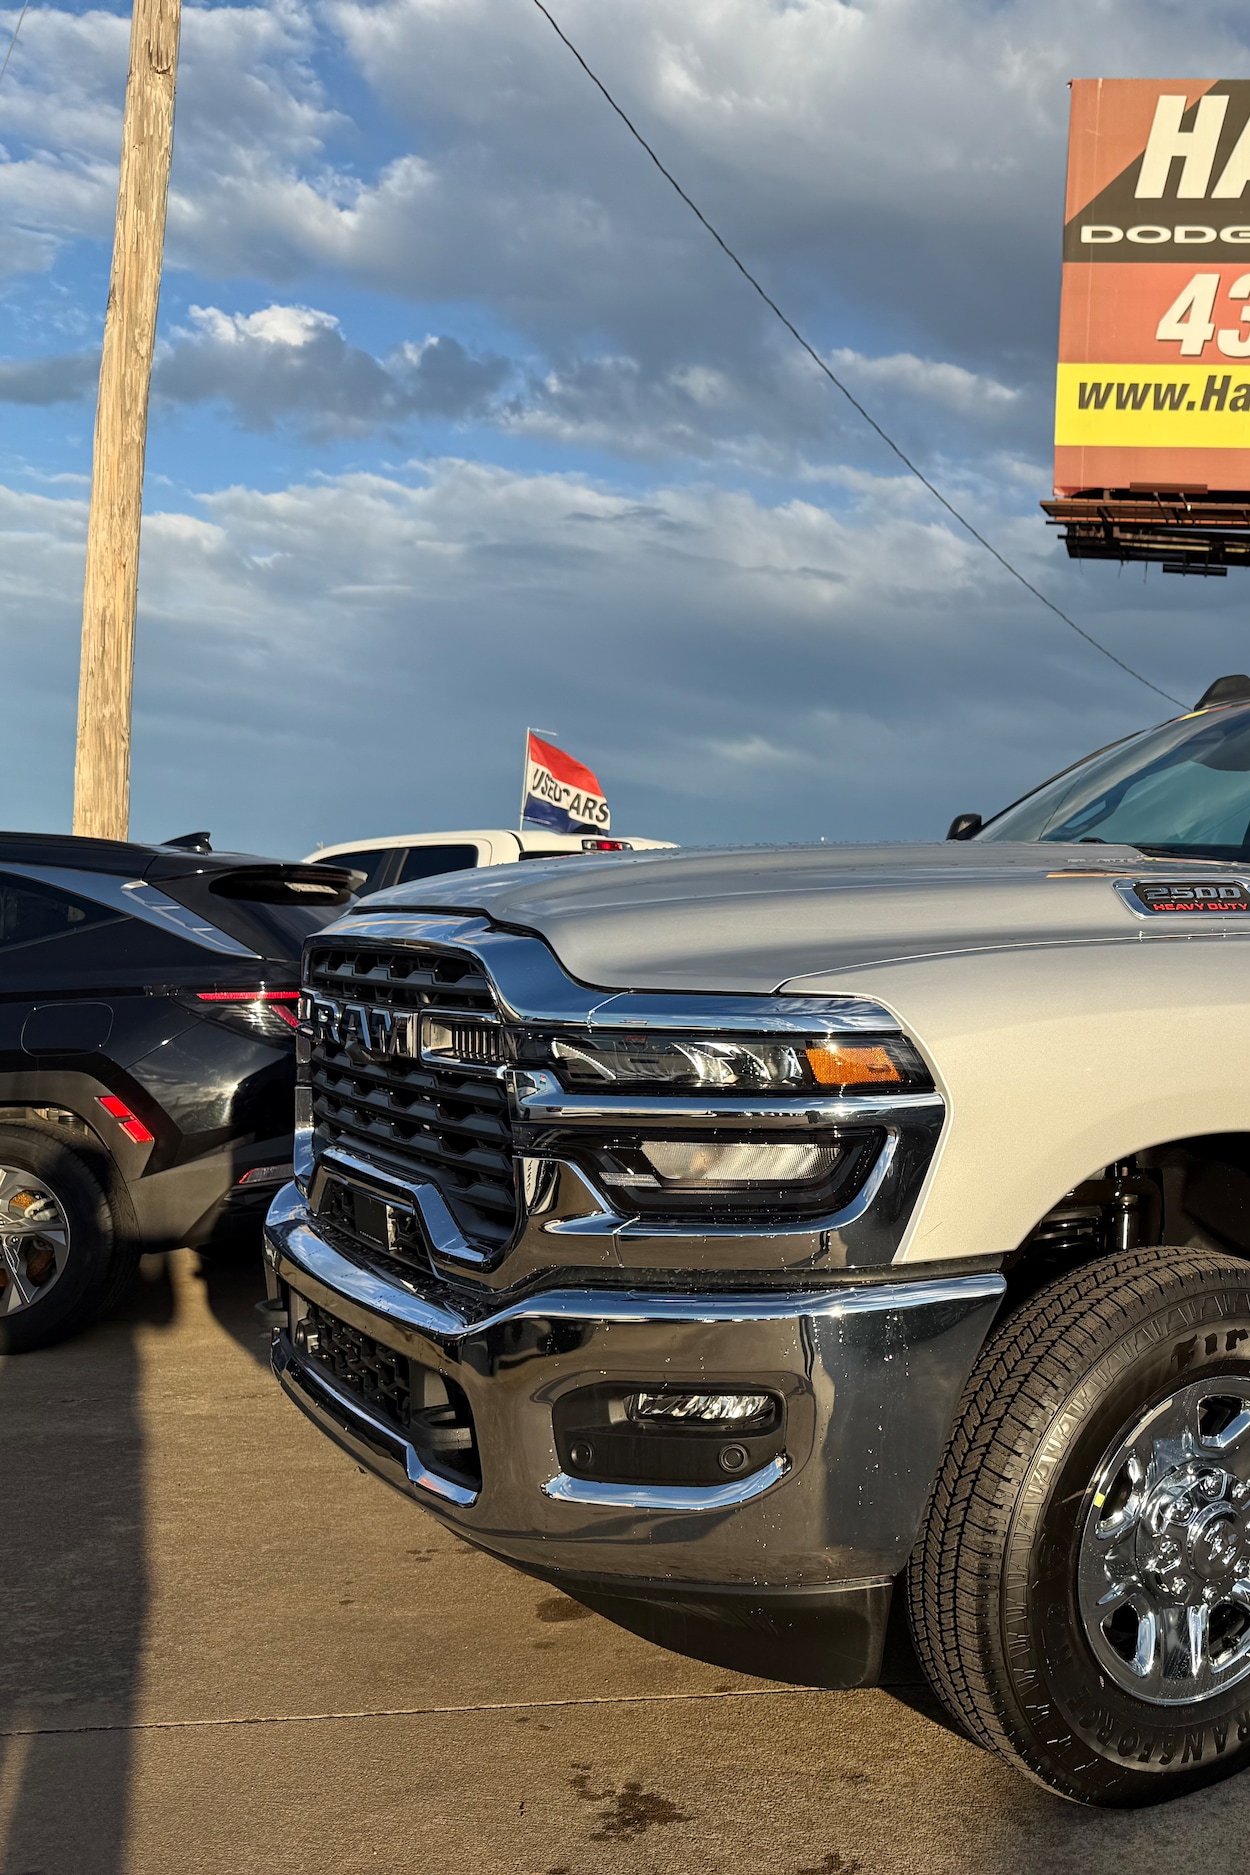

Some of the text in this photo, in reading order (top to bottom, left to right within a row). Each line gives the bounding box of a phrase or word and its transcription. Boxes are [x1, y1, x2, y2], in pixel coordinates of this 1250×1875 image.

[532, 768, 562, 803] USED
[1144, 886, 1242, 900] 2500
[1153, 902, 1248, 912] HEAVY DUTY
